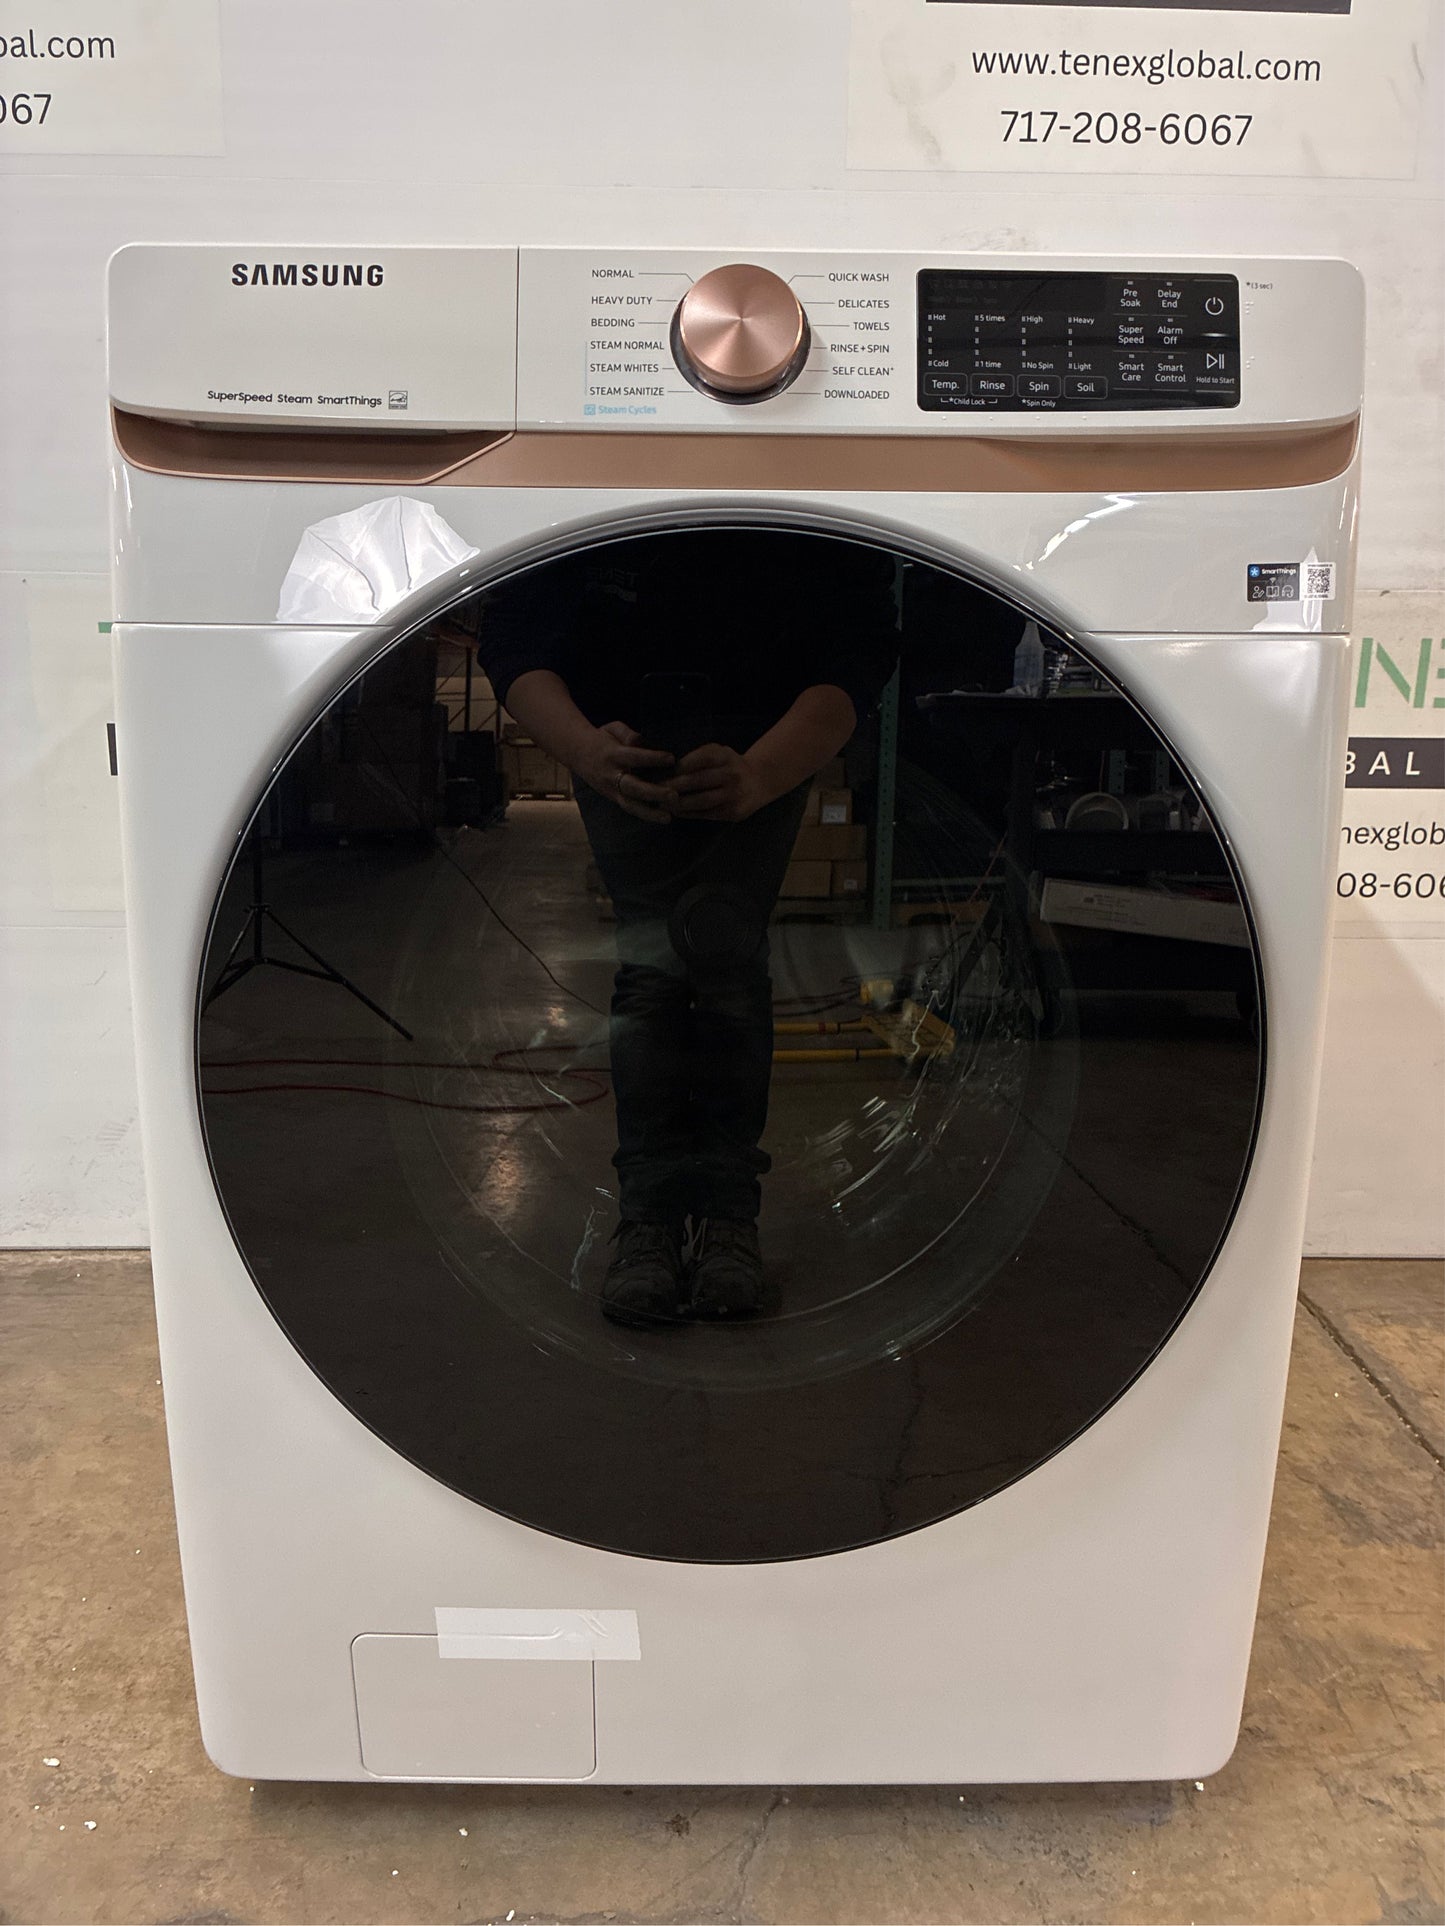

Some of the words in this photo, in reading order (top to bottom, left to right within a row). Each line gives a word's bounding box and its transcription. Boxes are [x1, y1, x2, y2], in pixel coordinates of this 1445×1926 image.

[972, 49, 1321, 85] www.tenexglobal.com
[1000, 110, 1253, 146] 717-208-6067
[231, 263, 384, 286] SAMSUNG
[591, 269, 634, 278] NORMAL
[828, 273, 858, 282] QUICK
[860, 273, 890, 282] WASH
[1123, 289, 1138, 298] Pre
[1157, 290, 1182, 300] Delay
[591, 296, 624, 304] HEAVY
[626, 296, 653, 304] DUTY
[838, 300, 890, 308] DELICATES
[1120, 299, 1141, 308] Soak
[1162, 300, 1178, 308] End
[591, 318, 635, 327] BEDDING
[1026, 316, 1043, 324] High
[1073, 316, 1094, 325] Heavy
[853, 322, 890, 330] TOWELS
[1158, 326, 1183, 334] Alarm
[1118, 326, 1143, 336] Super
[1118, 336, 1144, 346] Speed
[1163, 336, 1178, 344] Off
[590, 341, 622, 350] STEAM
[624, 342, 664, 350] NORMAL
[830, 344, 859, 352] RINSE
[867, 344, 890, 353] SPIN
[590, 364, 622, 372] STEAM
[624, 364, 658, 372] WHITES
[1038, 362, 1054, 370] Spin
[1073, 363, 1092, 371] Light
[1118, 362, 1144, 370] Smart
[1158, 363, 1184, 372] Smart
[832, 366, 856, 376] SELF
[1122, 372, 1142, 381] Care
[1155, 374, 1186, 382] Control
[932, 380, 960, 390] Temp.
[980, 380, 1006, 390] Rinse
[1029, 382, 1050, 392] Spin
[1077, 382, 1095, 392] Soil
[590, 387, 620, 396] STEAM
[623, 387, 664, 396] SANITIZE
[824, 390, 890, 399] DOWNLOADED
[207, 390, 272, 404] SuperSpeed
[277, 394, 312, 404] Steam
[317, 396, 382, 408] SmartThings
[1041, 400, 1056, 408] Only
[598, 406, 627, 414] Steam
[628, 406, 657, 416] Cycles
